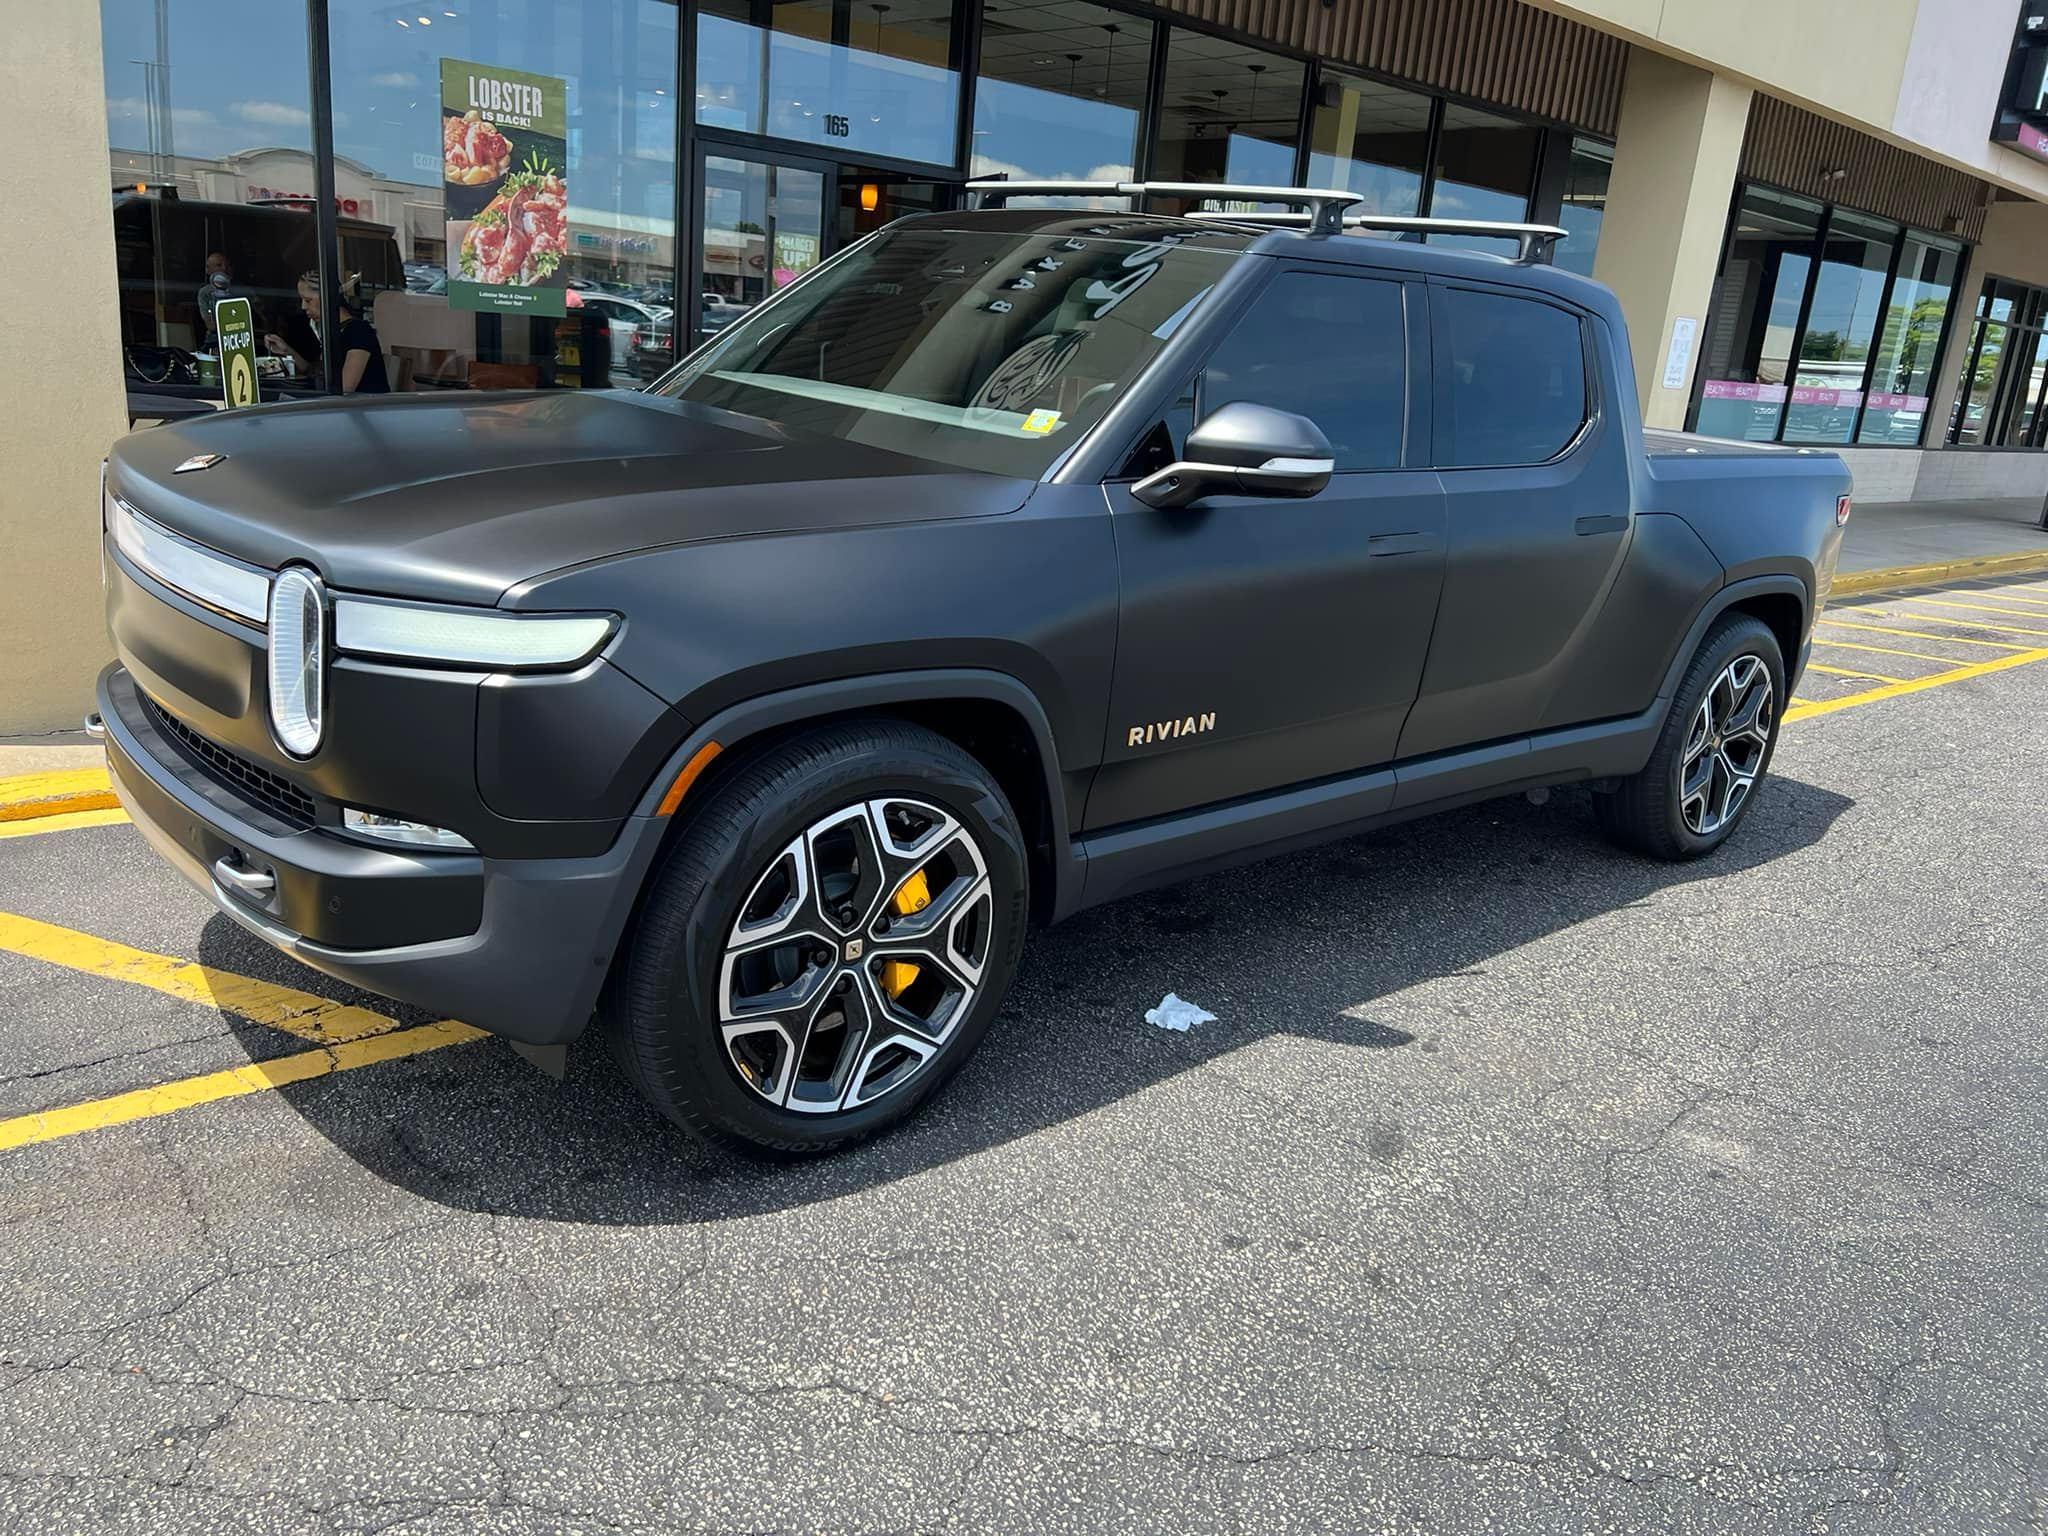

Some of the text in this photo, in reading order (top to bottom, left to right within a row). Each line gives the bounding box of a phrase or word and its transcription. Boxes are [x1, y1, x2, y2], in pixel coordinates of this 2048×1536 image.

[469, 76, 543, 117] LOBSTER
[482, 111, 531, 127] IS BACK!
[823, 114, 849, 138] 165
[784, 250, 811, 267] UP!
[223, 332, 250, 352] PICK-UP
[237, 369, 247, 402] 2
[1127, 711, 1216, 747] RIVIAN
